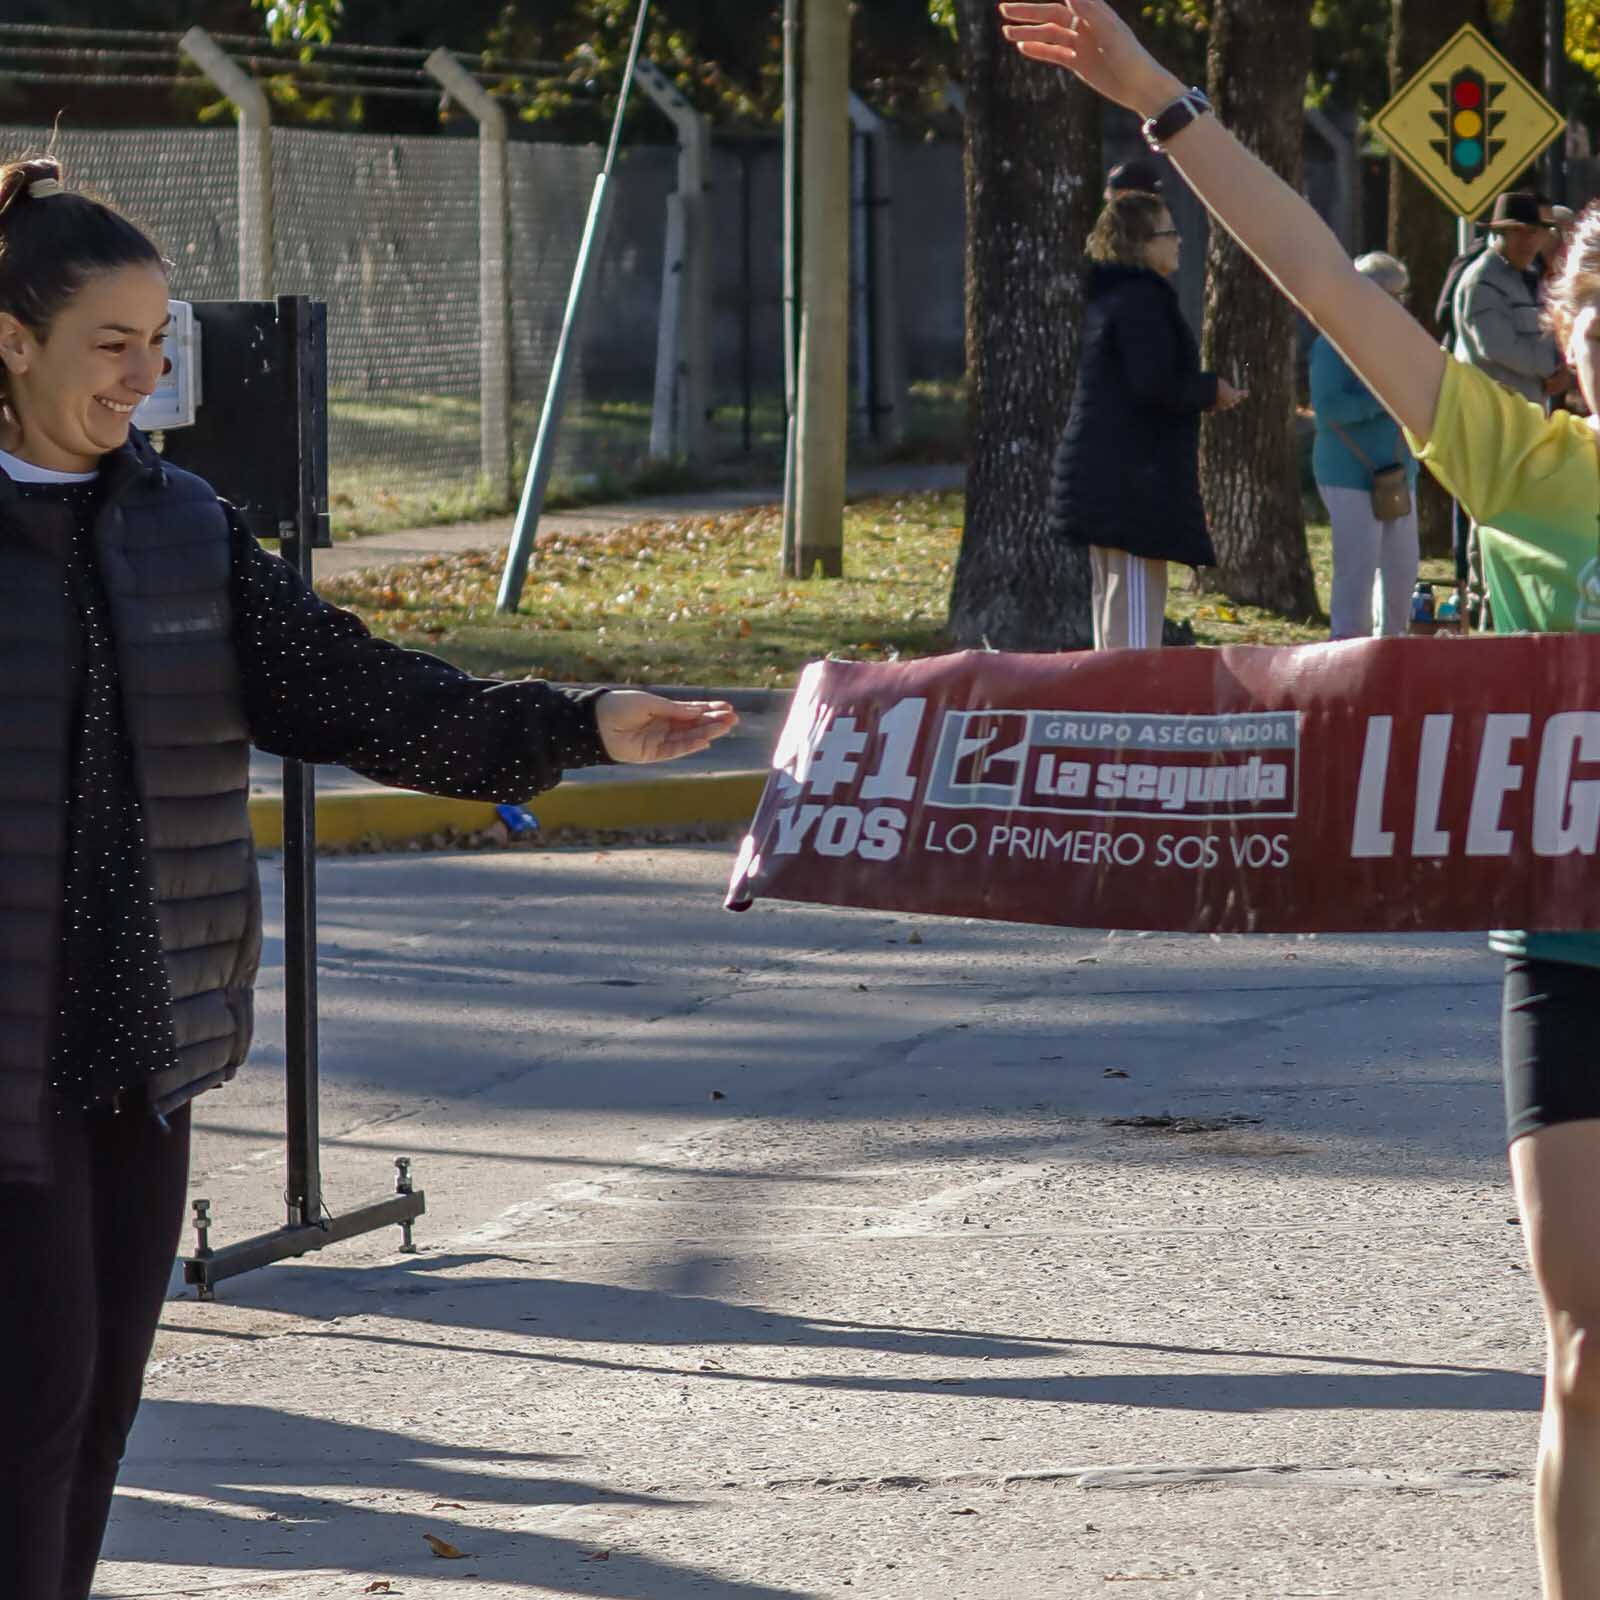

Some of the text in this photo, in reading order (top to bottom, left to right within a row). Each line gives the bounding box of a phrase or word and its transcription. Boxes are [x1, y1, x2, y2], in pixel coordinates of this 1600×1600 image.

[1045, 721, 1288, 745] GRUPO ASEGURADOR
[1034, 753, 1287, 810] La segunda
[925, 821, 1290, 869] LO PRIMERO SOS VOS
